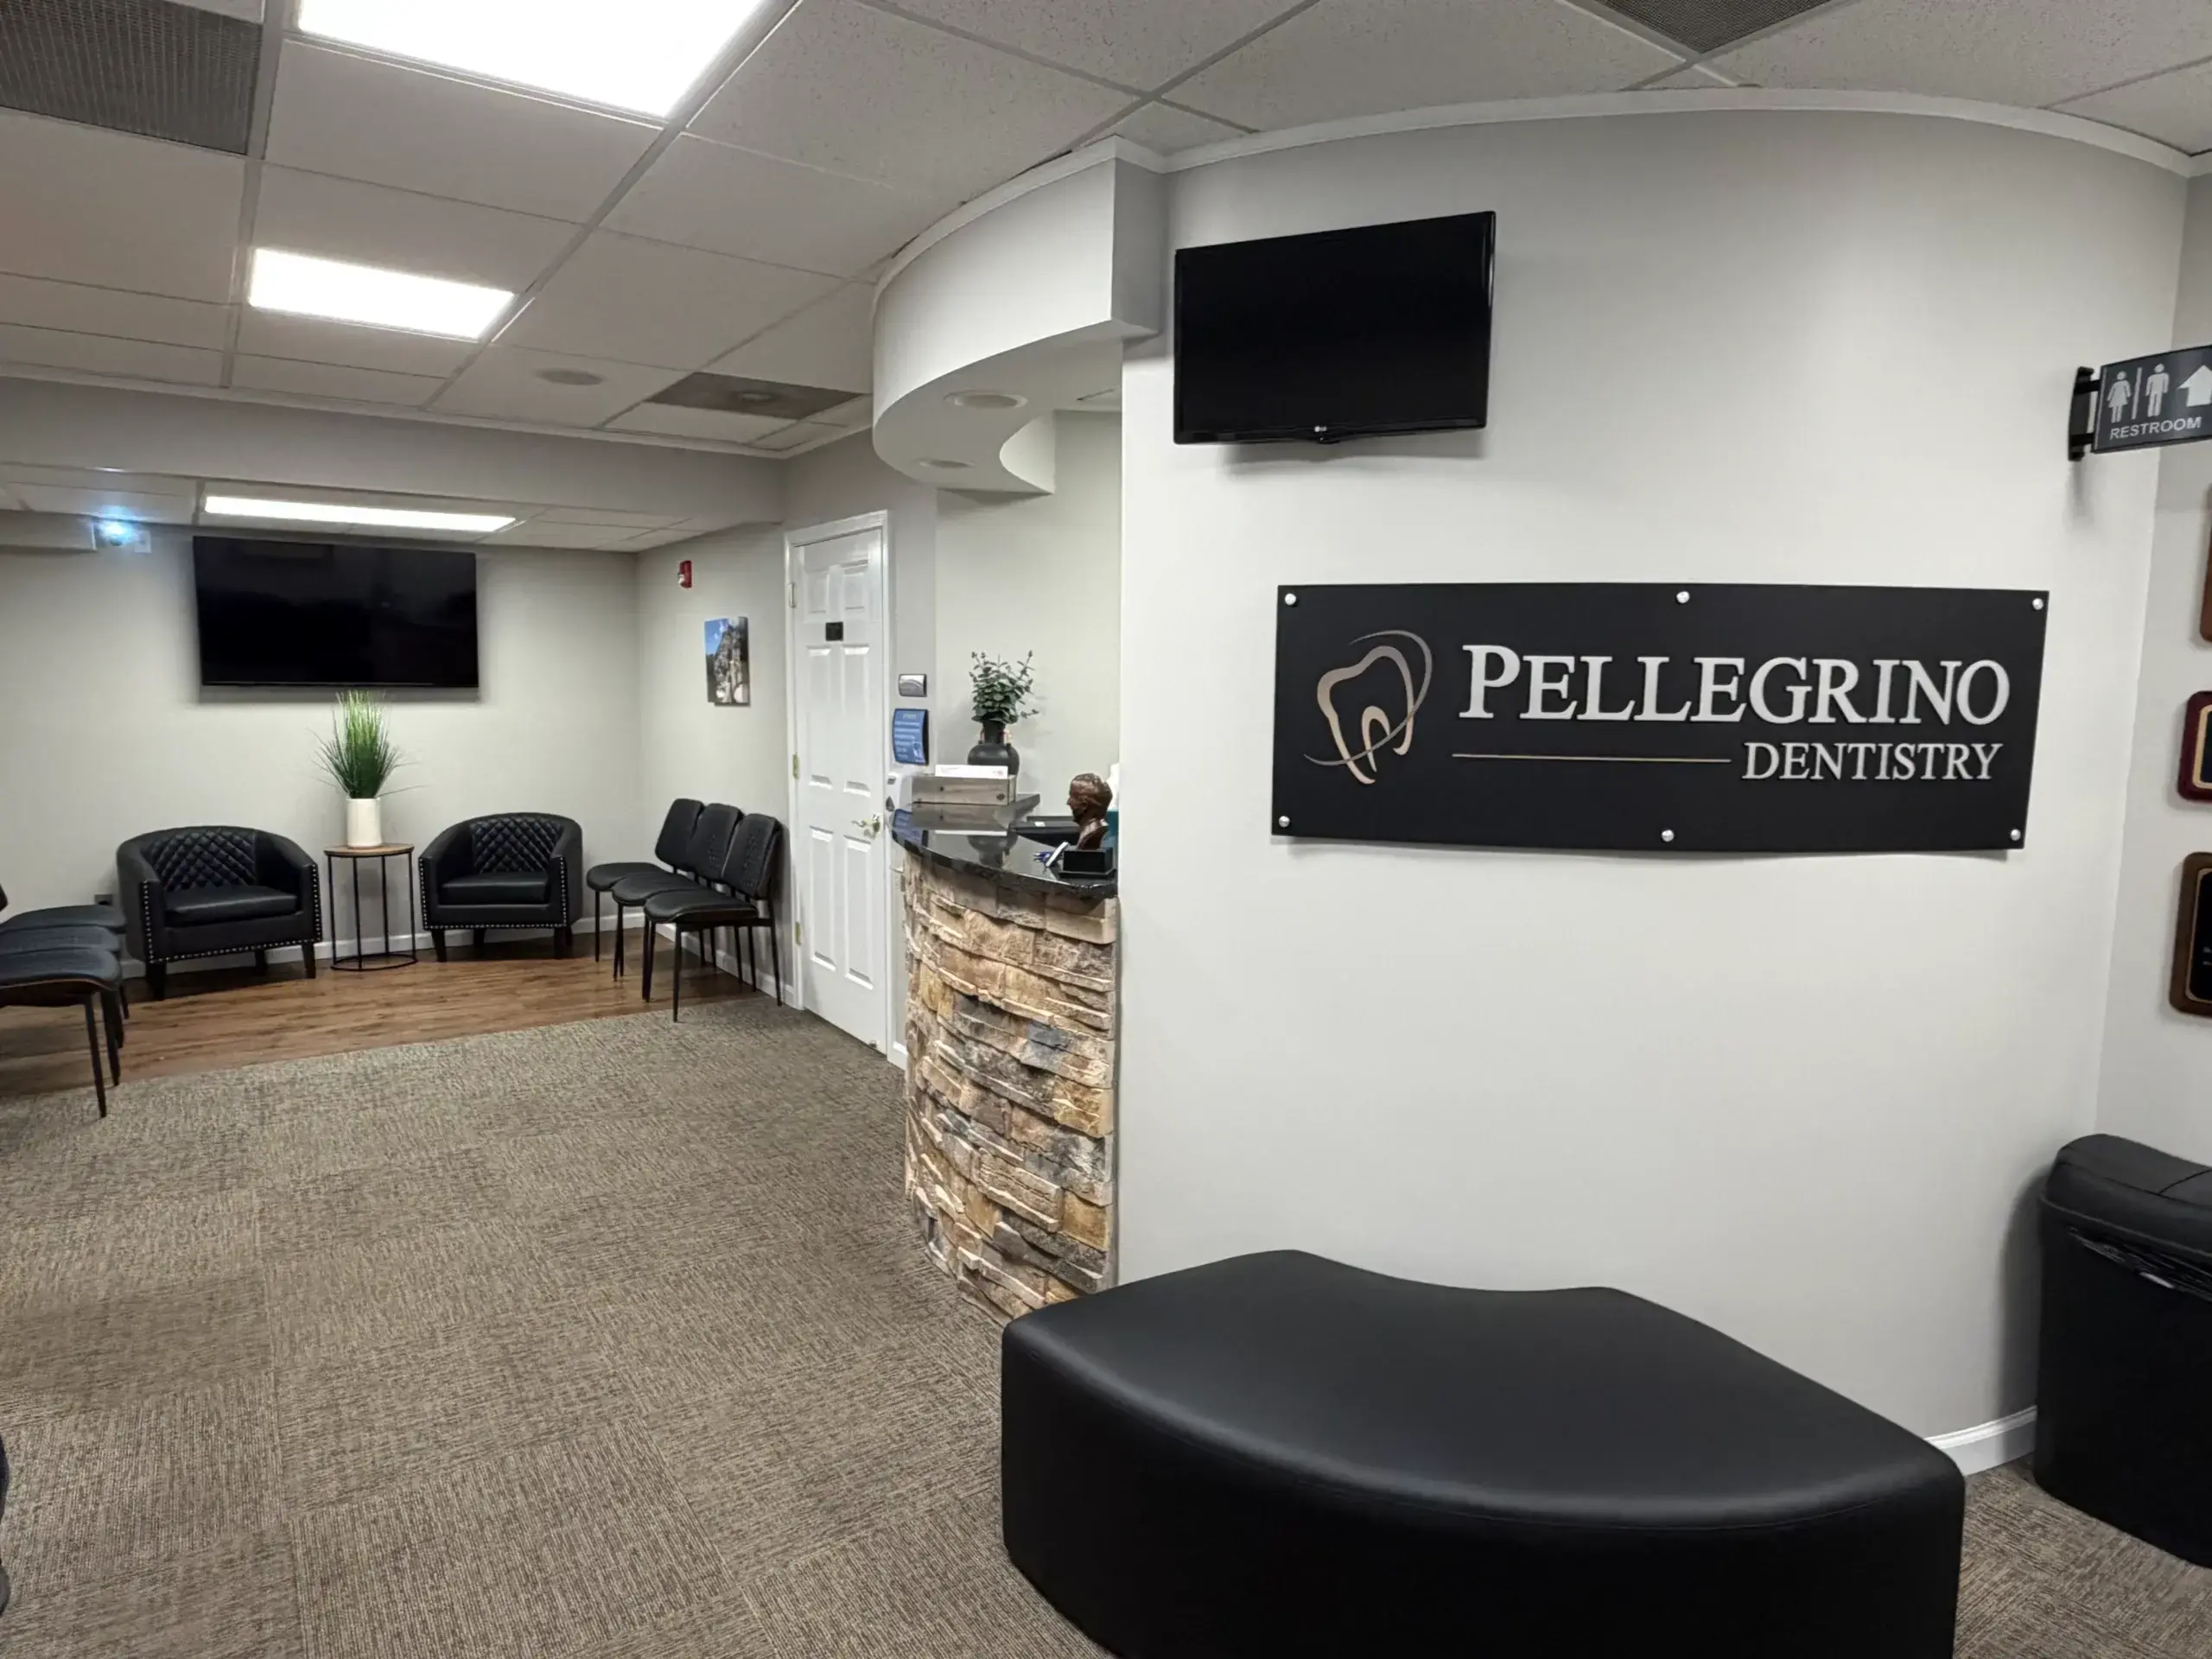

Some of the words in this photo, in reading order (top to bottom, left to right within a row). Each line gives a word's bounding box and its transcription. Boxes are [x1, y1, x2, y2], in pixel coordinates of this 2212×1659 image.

[2110, 416, 2202, 439] RESTROOM
[1459, 644, 2011, 726] PELLEGRINO
[1741, 741, 2003, 780] DENTISTRY
